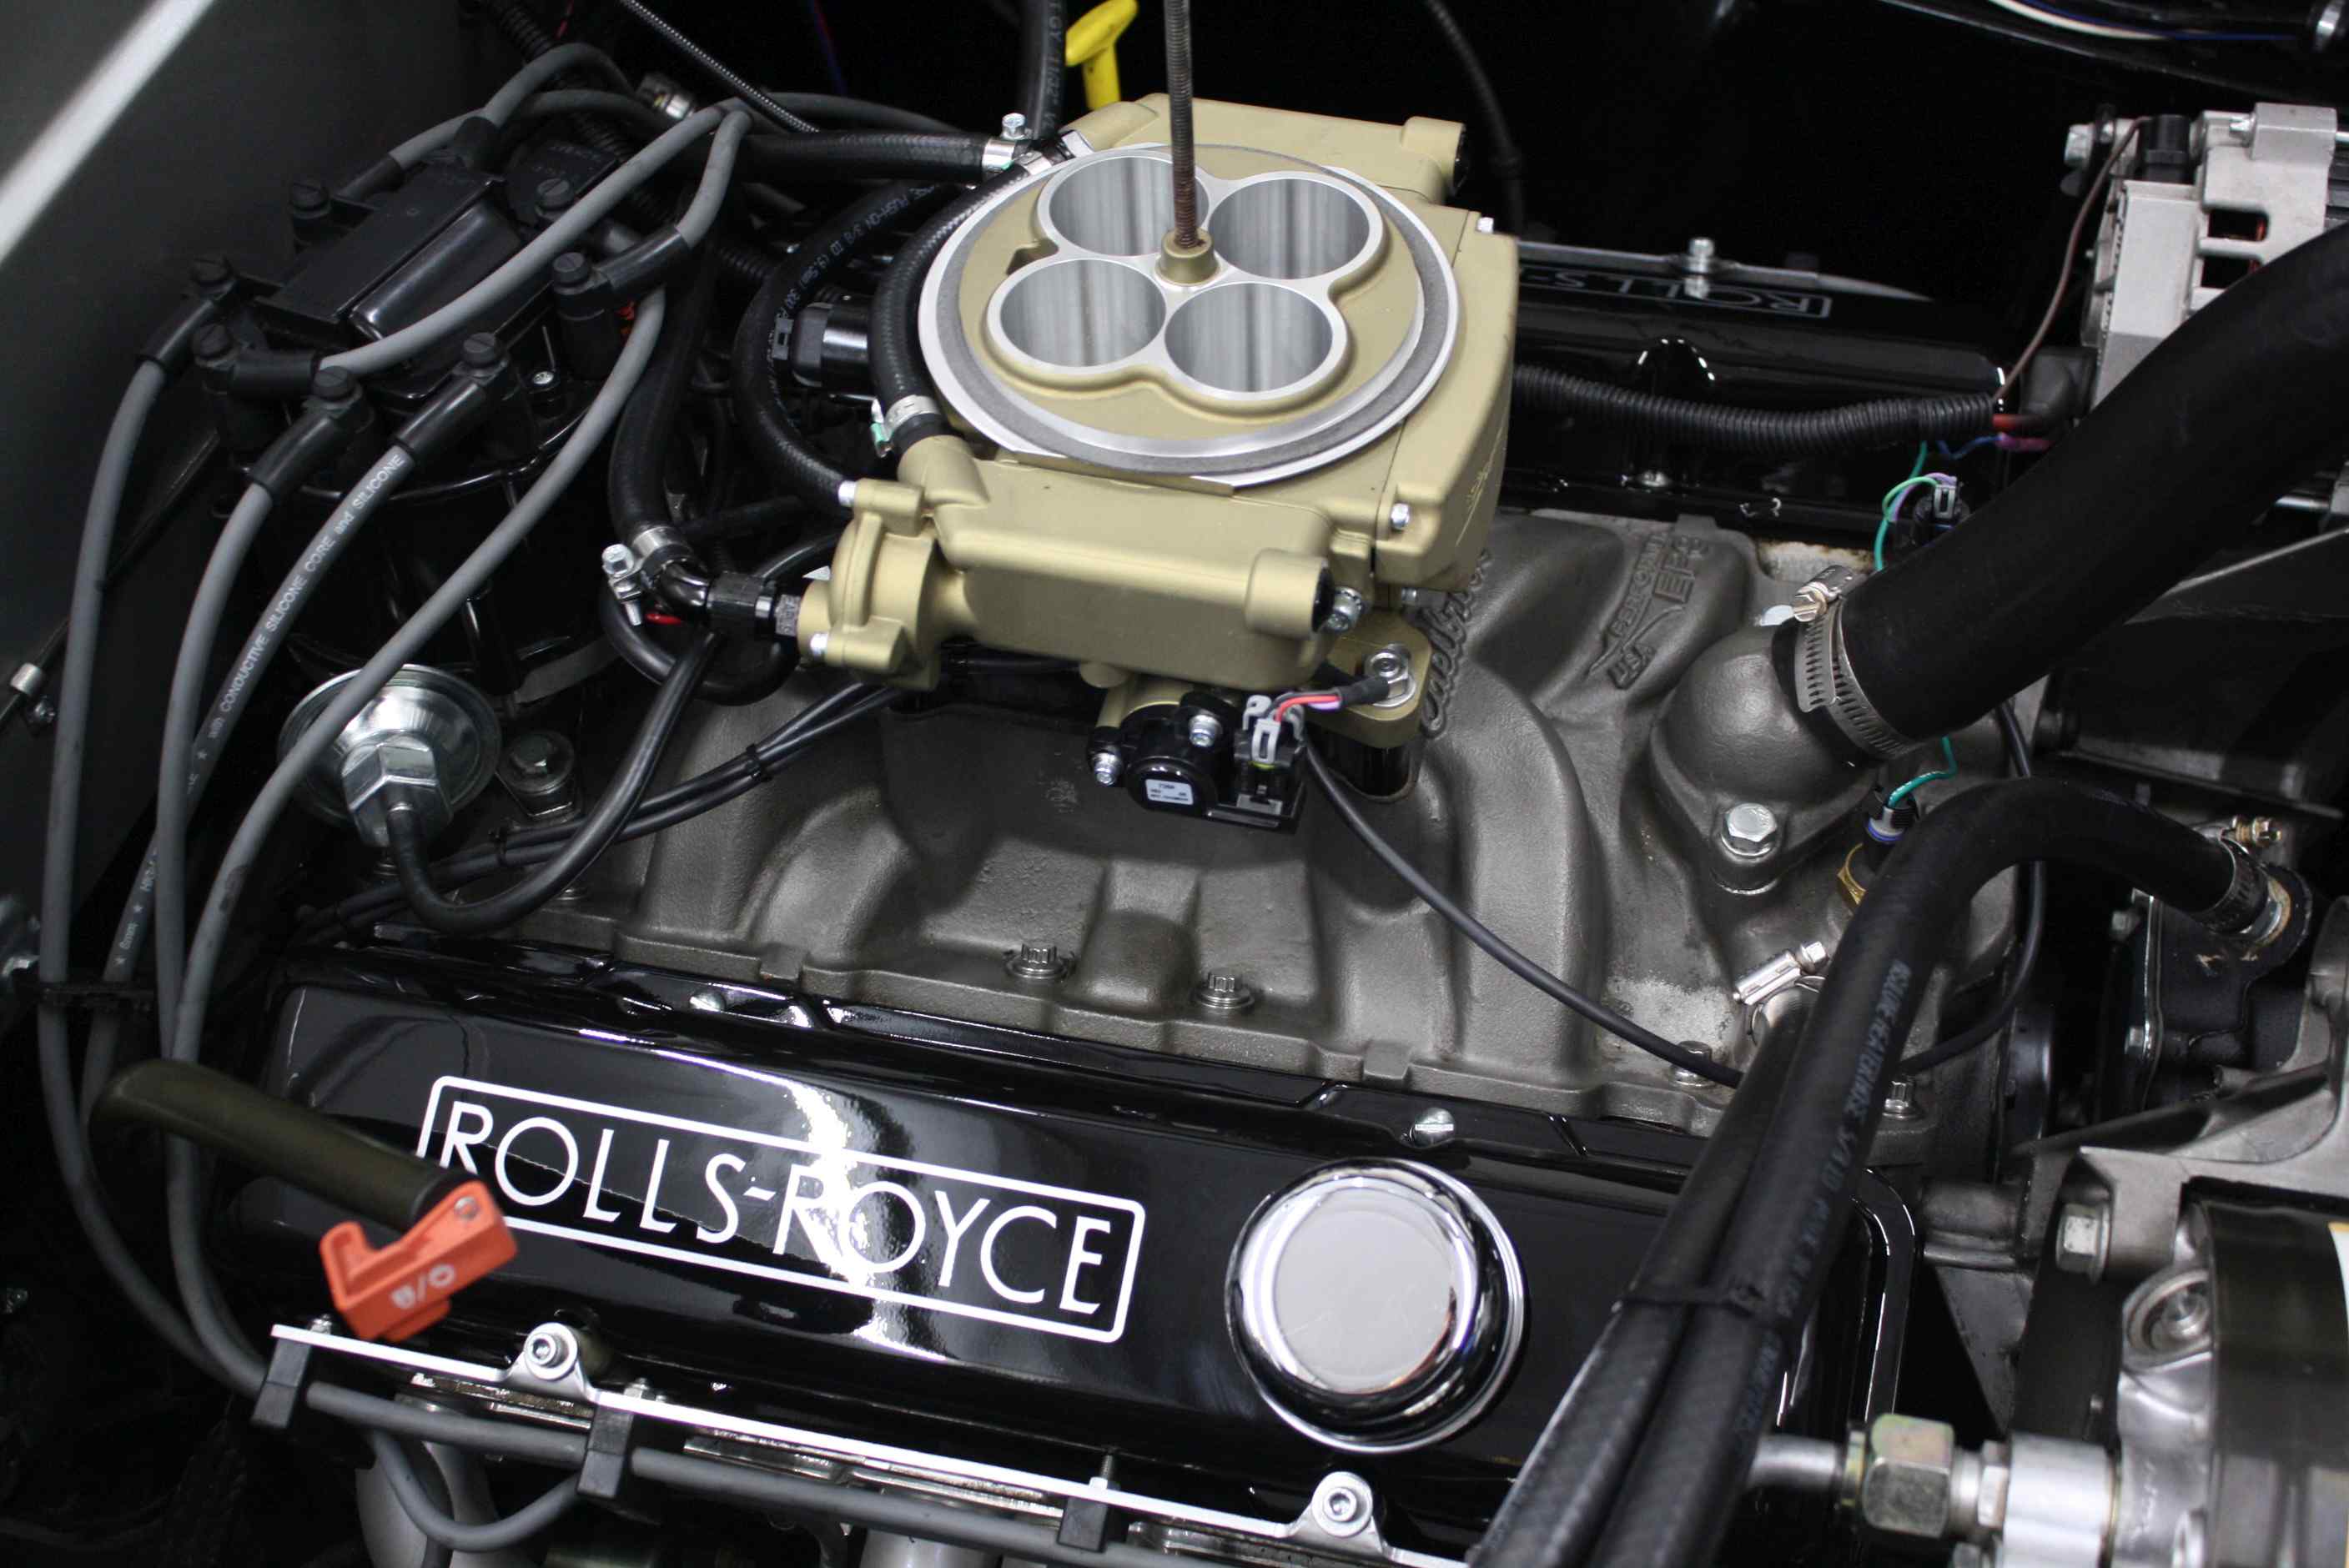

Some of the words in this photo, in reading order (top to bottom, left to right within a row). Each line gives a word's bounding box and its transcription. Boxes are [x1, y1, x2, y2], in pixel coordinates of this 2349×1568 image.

[219, 632, 270, 712] CONDUCTIVE
[265, 575, 309, 633] SILICONE
[304, 534, 337, 573] CORE
[333, 510, 355, 535] and
[352, 454, 405, 510] SILICONE
[439, 1099, 1112, 1315] ROLLS-ROYCE
